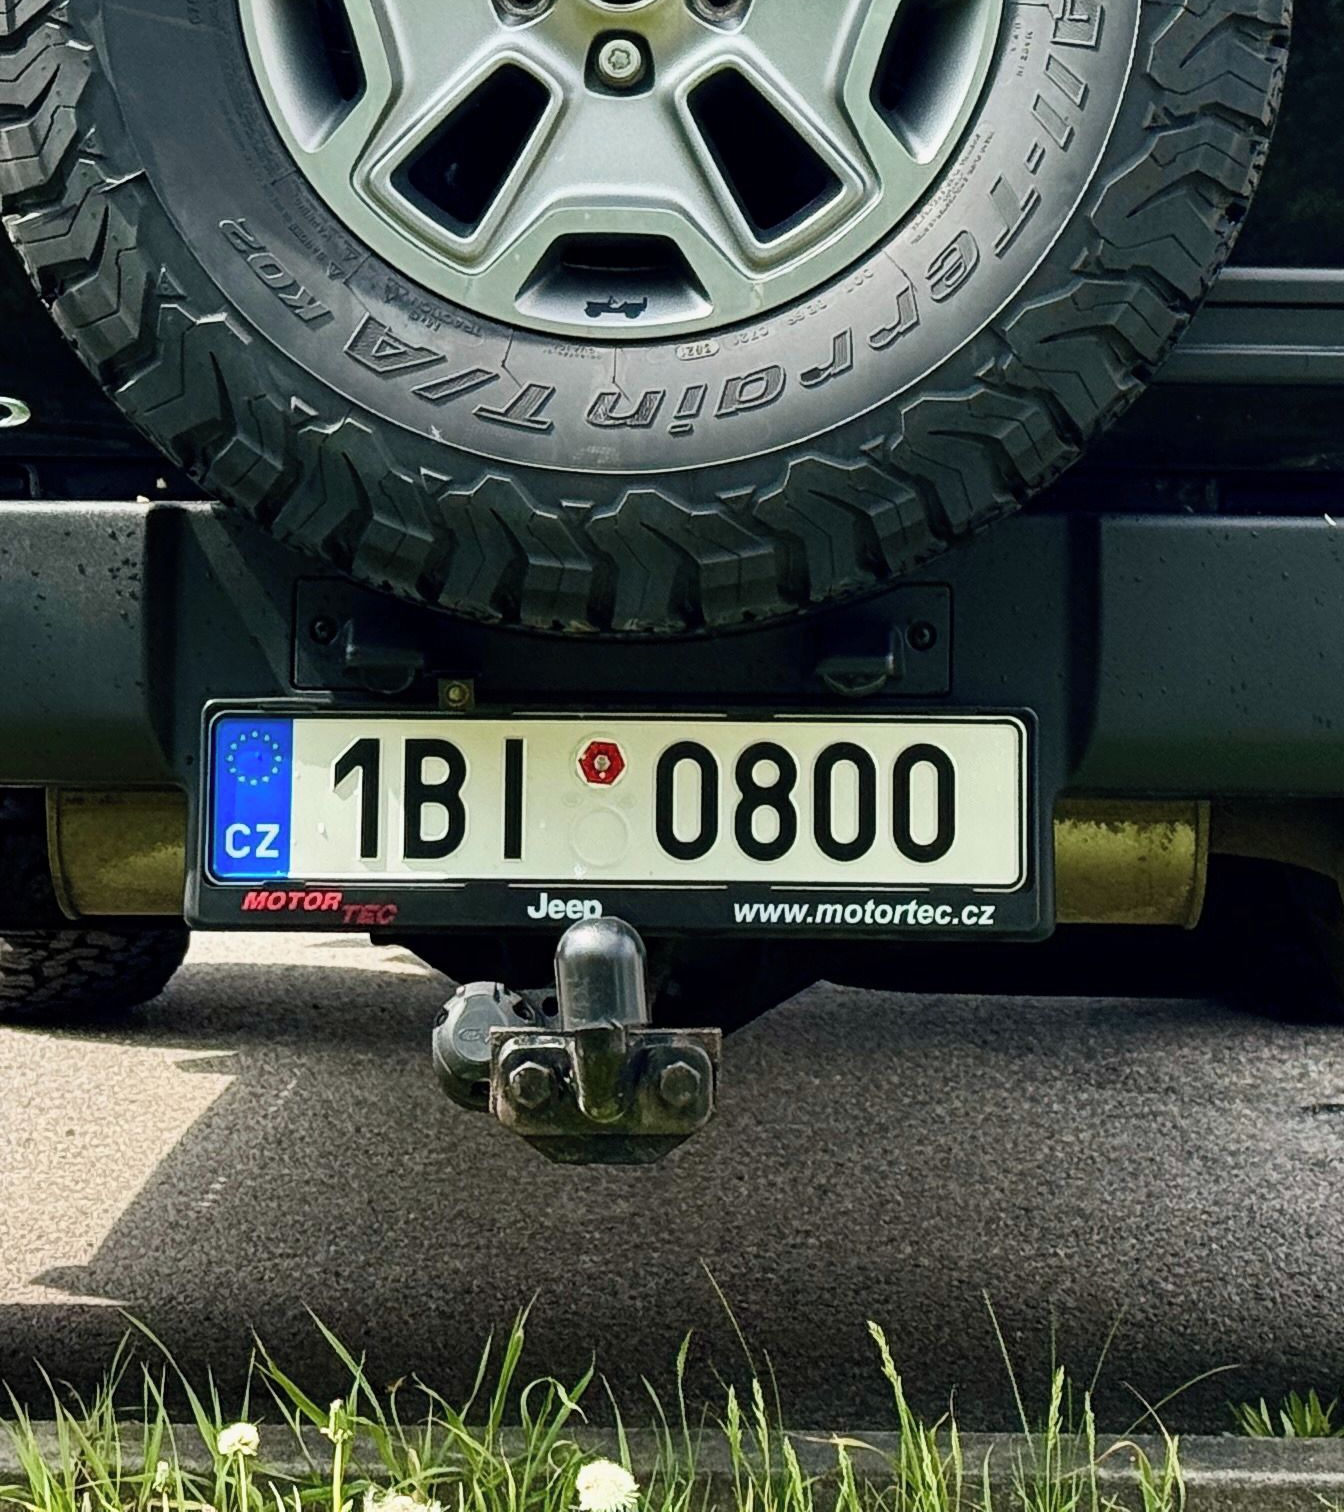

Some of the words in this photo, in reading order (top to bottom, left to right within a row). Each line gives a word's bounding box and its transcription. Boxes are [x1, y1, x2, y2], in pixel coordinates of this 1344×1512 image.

[217, 217, 335, 324] KO2
[331, 738, 523, 860] 1BI
[656, 740, 955, 862] 0800
[223, 823, 279, 859] CZ
[242, 891, 342, 910] MOTOR
[342, 904, 398, 925] TEC
[527, 892, 603, 919] Jeep
[733, 900, 996, 925] www.motortec.cz
